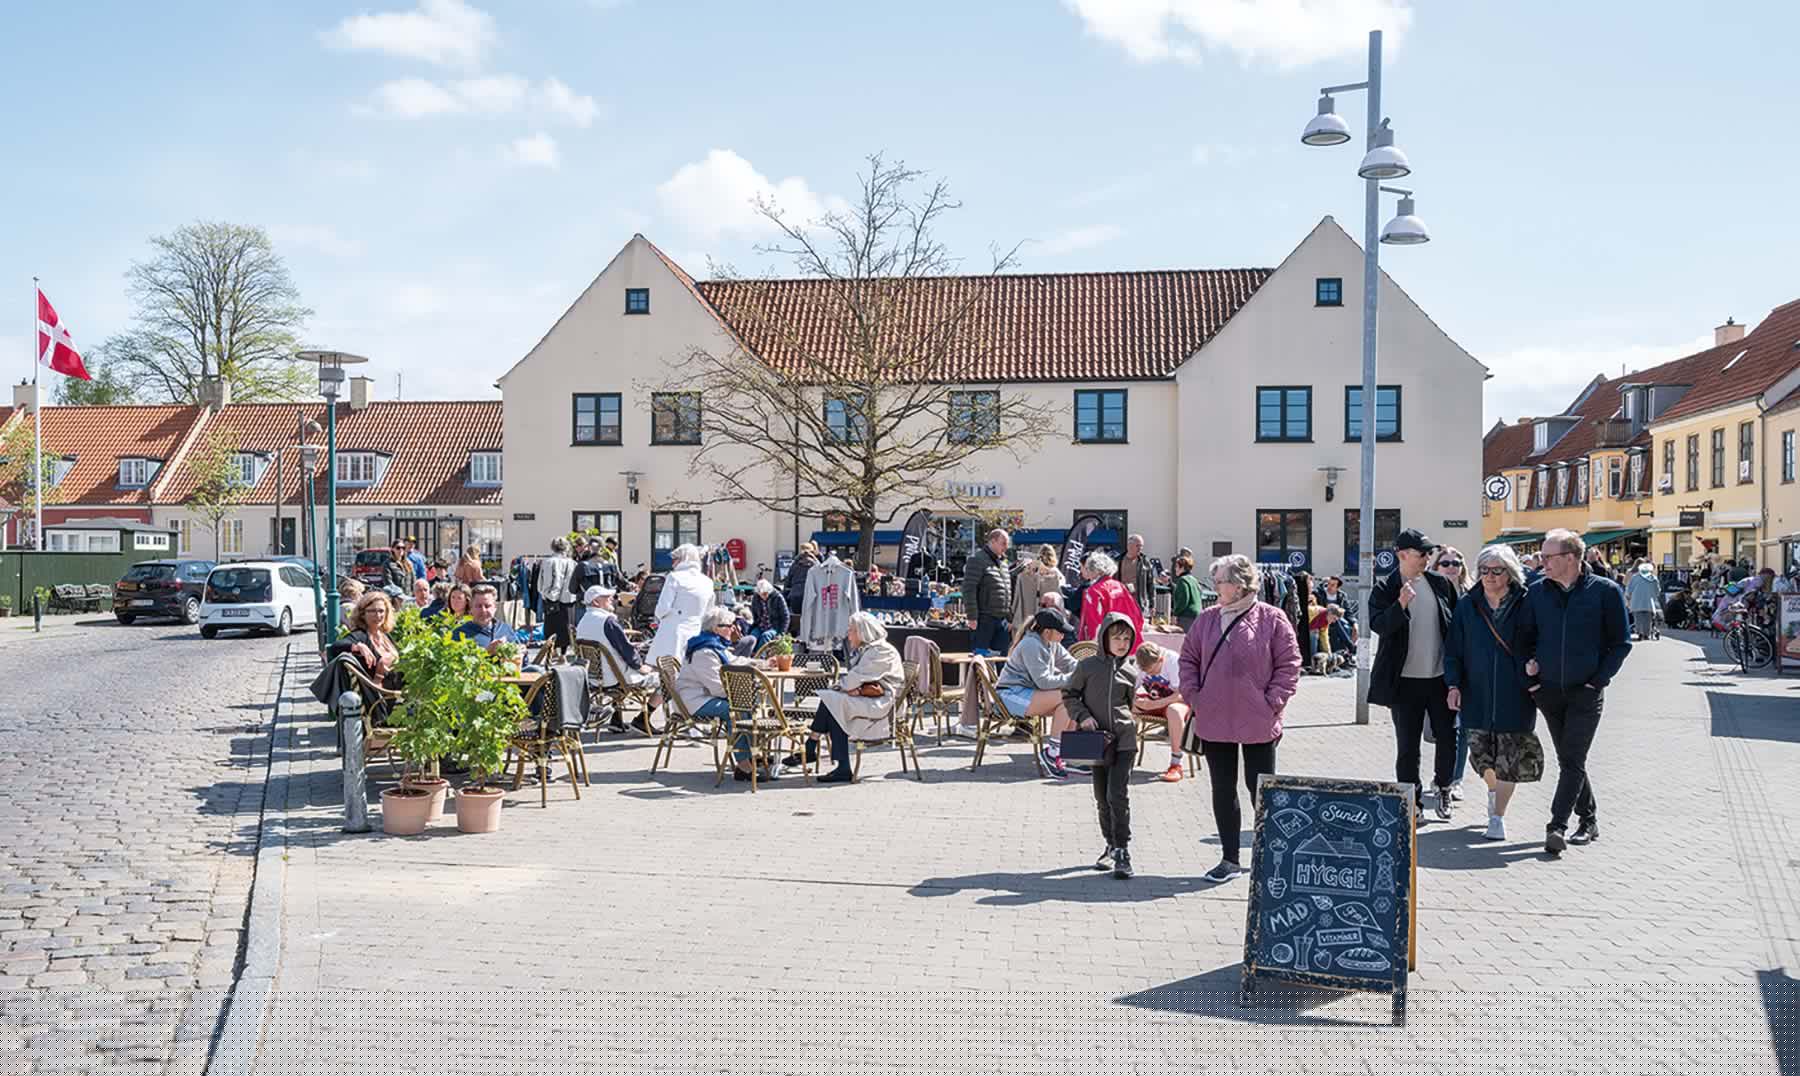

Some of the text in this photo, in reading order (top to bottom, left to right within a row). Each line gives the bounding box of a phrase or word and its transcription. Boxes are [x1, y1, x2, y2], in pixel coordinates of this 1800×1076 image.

[1321, 804, 1367, 824] Sundt
[1296, 863, 1367, 889] HYGGE
[1270, 903, 1308, 933] MAD
